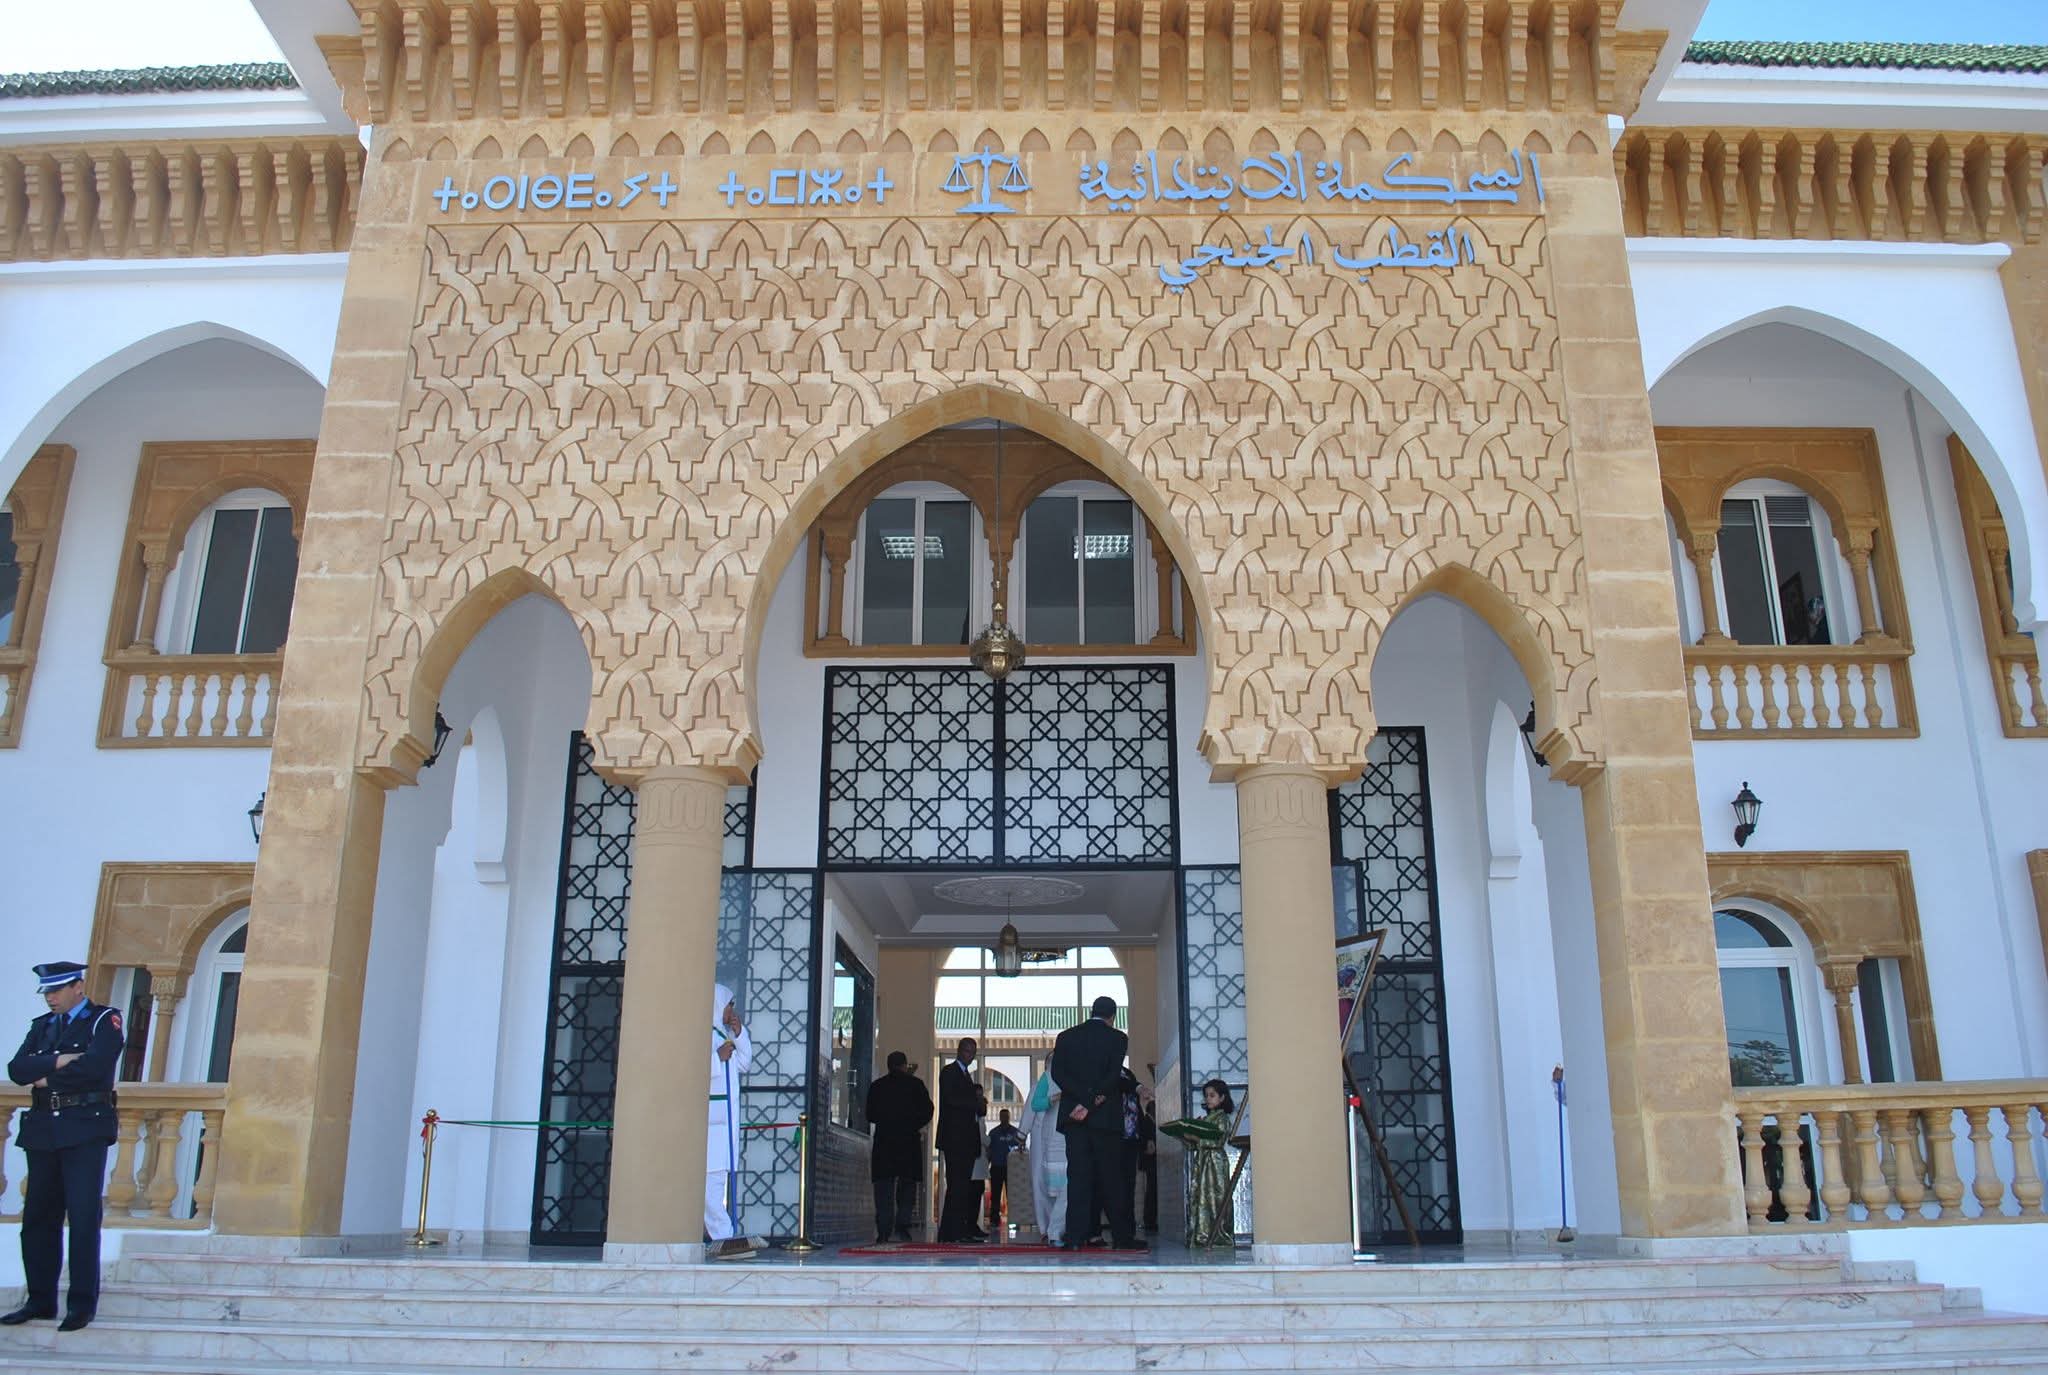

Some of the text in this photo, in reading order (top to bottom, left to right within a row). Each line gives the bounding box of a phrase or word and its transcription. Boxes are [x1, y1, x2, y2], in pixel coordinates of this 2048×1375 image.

[1079, 148, 1545, 211] المحكمة الابتدائية
[1159, 224, 1475, 295] القطب الجنحي
